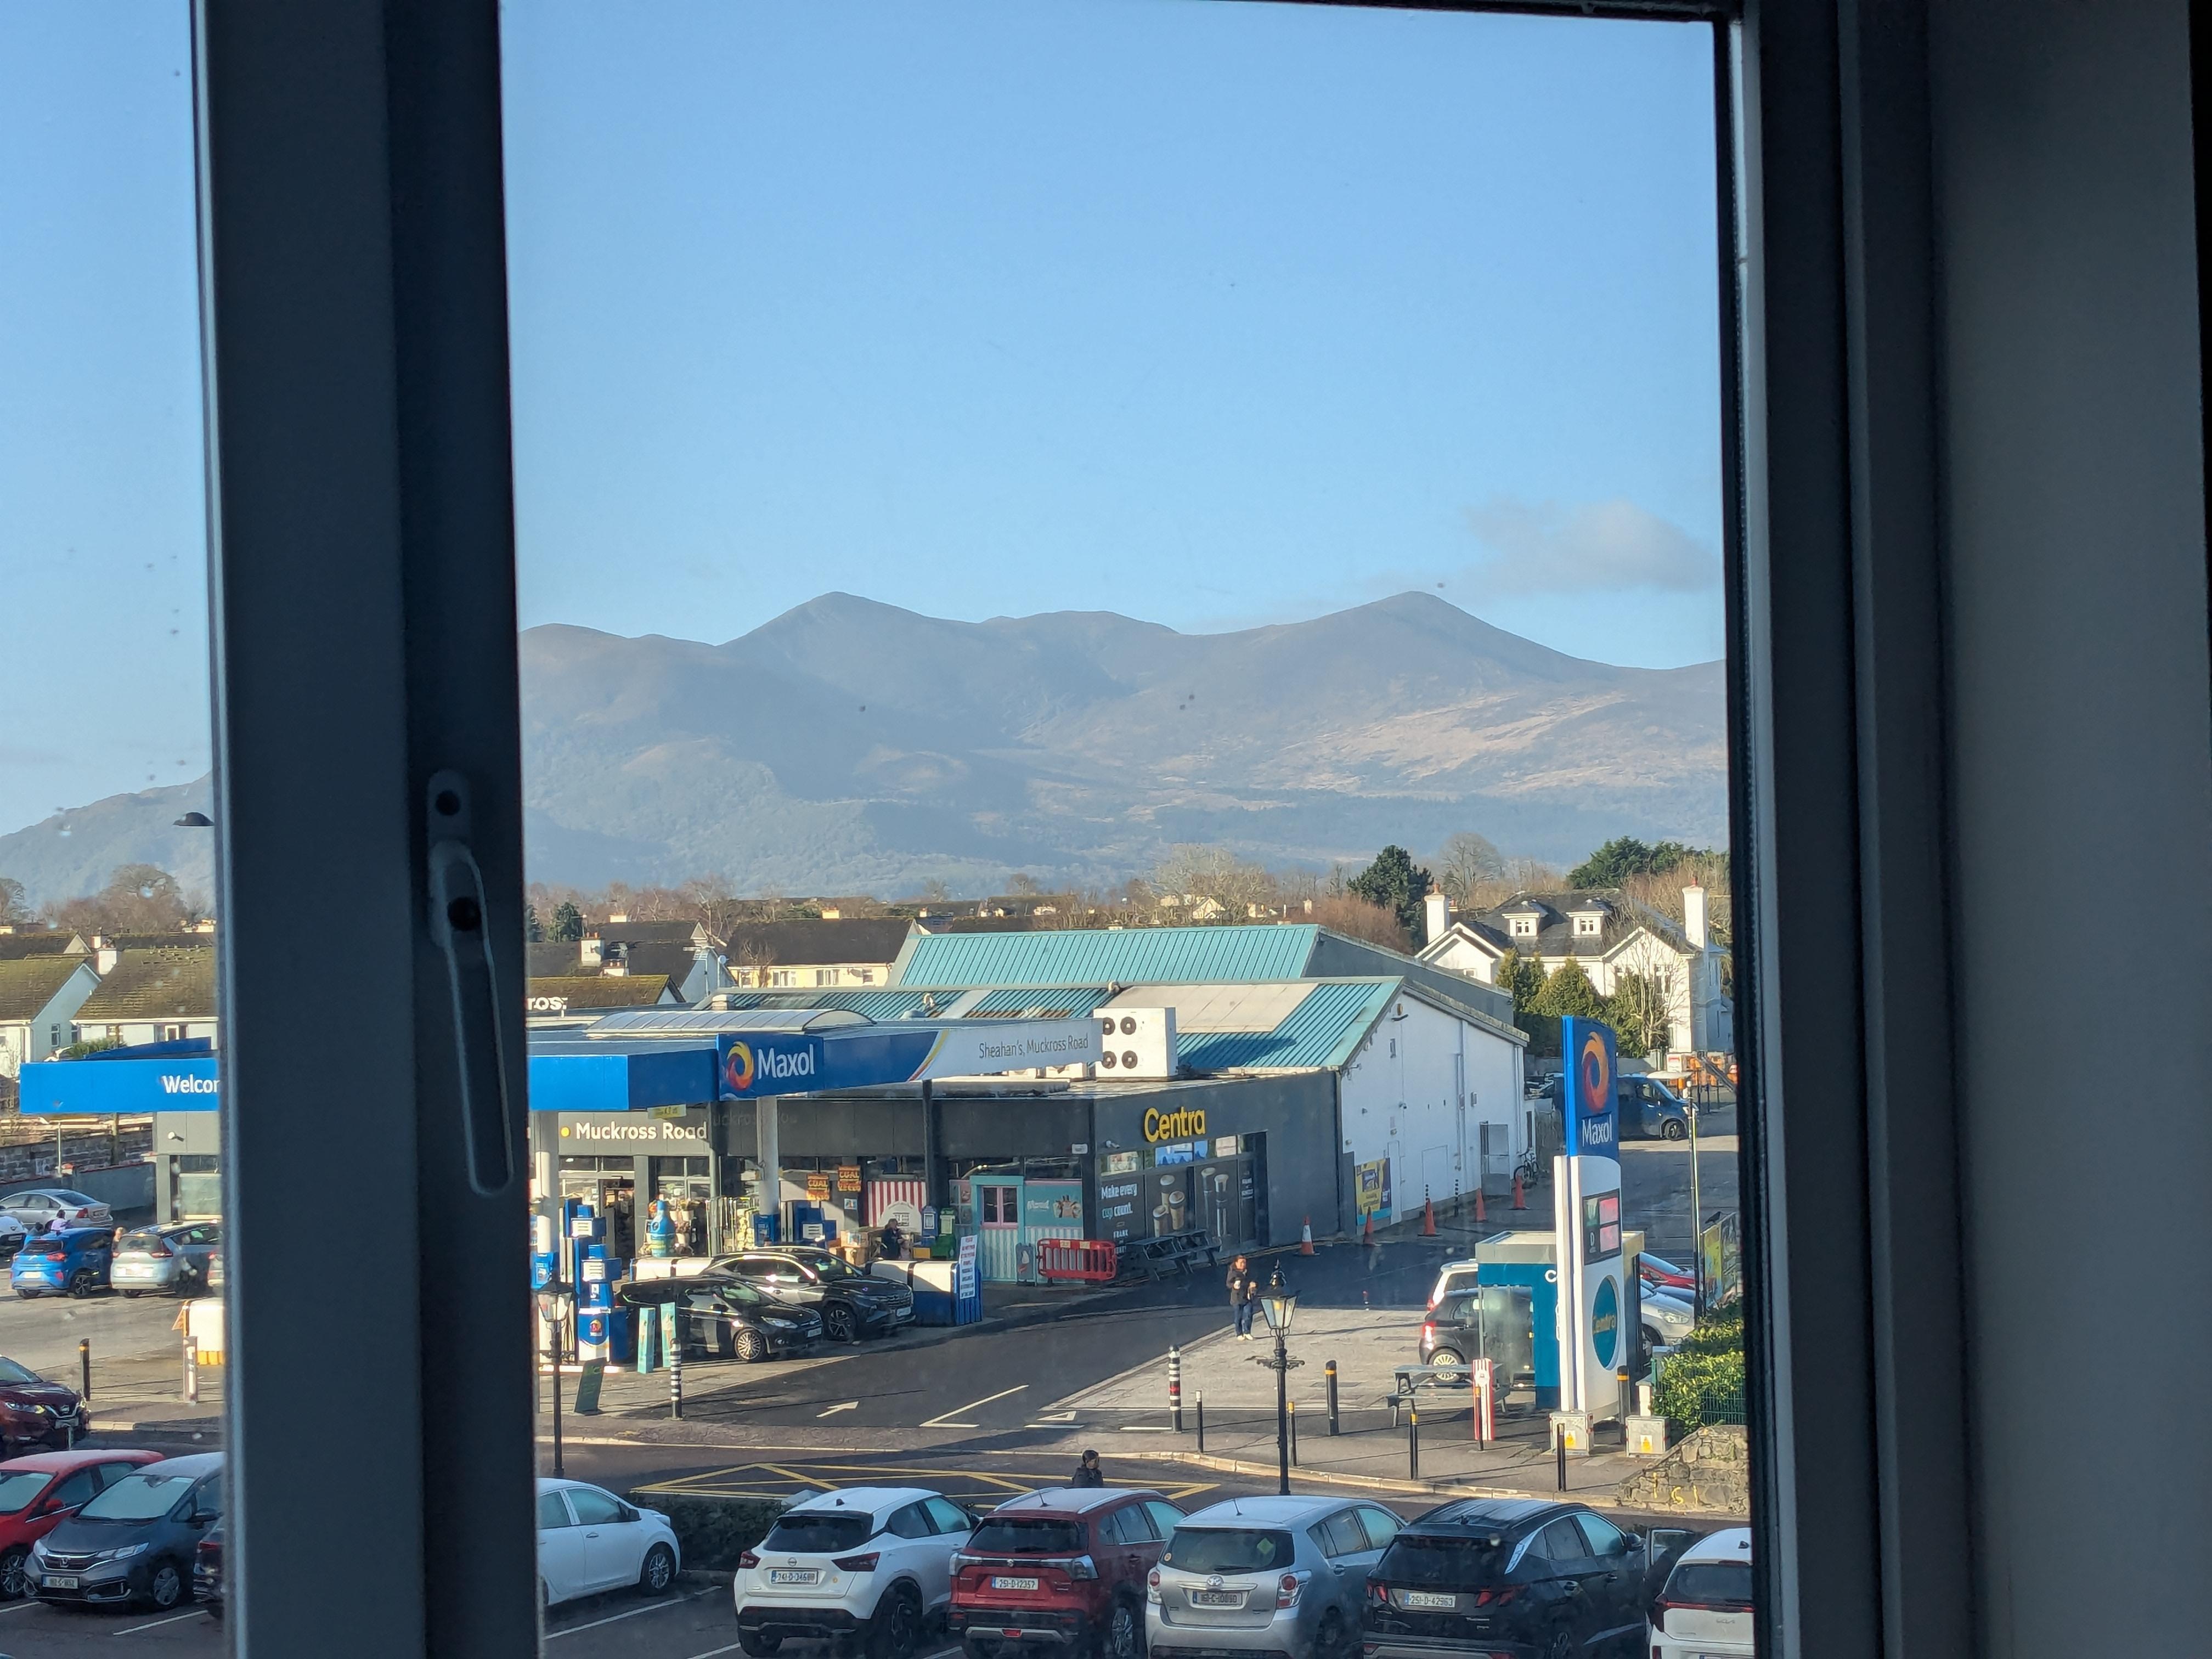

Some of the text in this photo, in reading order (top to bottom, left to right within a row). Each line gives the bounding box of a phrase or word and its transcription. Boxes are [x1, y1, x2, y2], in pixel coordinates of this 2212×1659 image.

[1026, 1037, 1066, 1053] Muckross
[1068, 1033, 1088, 1049] Road
[758, 1043, 815, 1080] Maxol
[576, 1121, 707, 1139] Muckross Road
[1144, 1106, 1206, 1142] Centra
[1582, 1114, 1612, 1147] Maxol
[1101, 1184, 1120, 1200] Make
